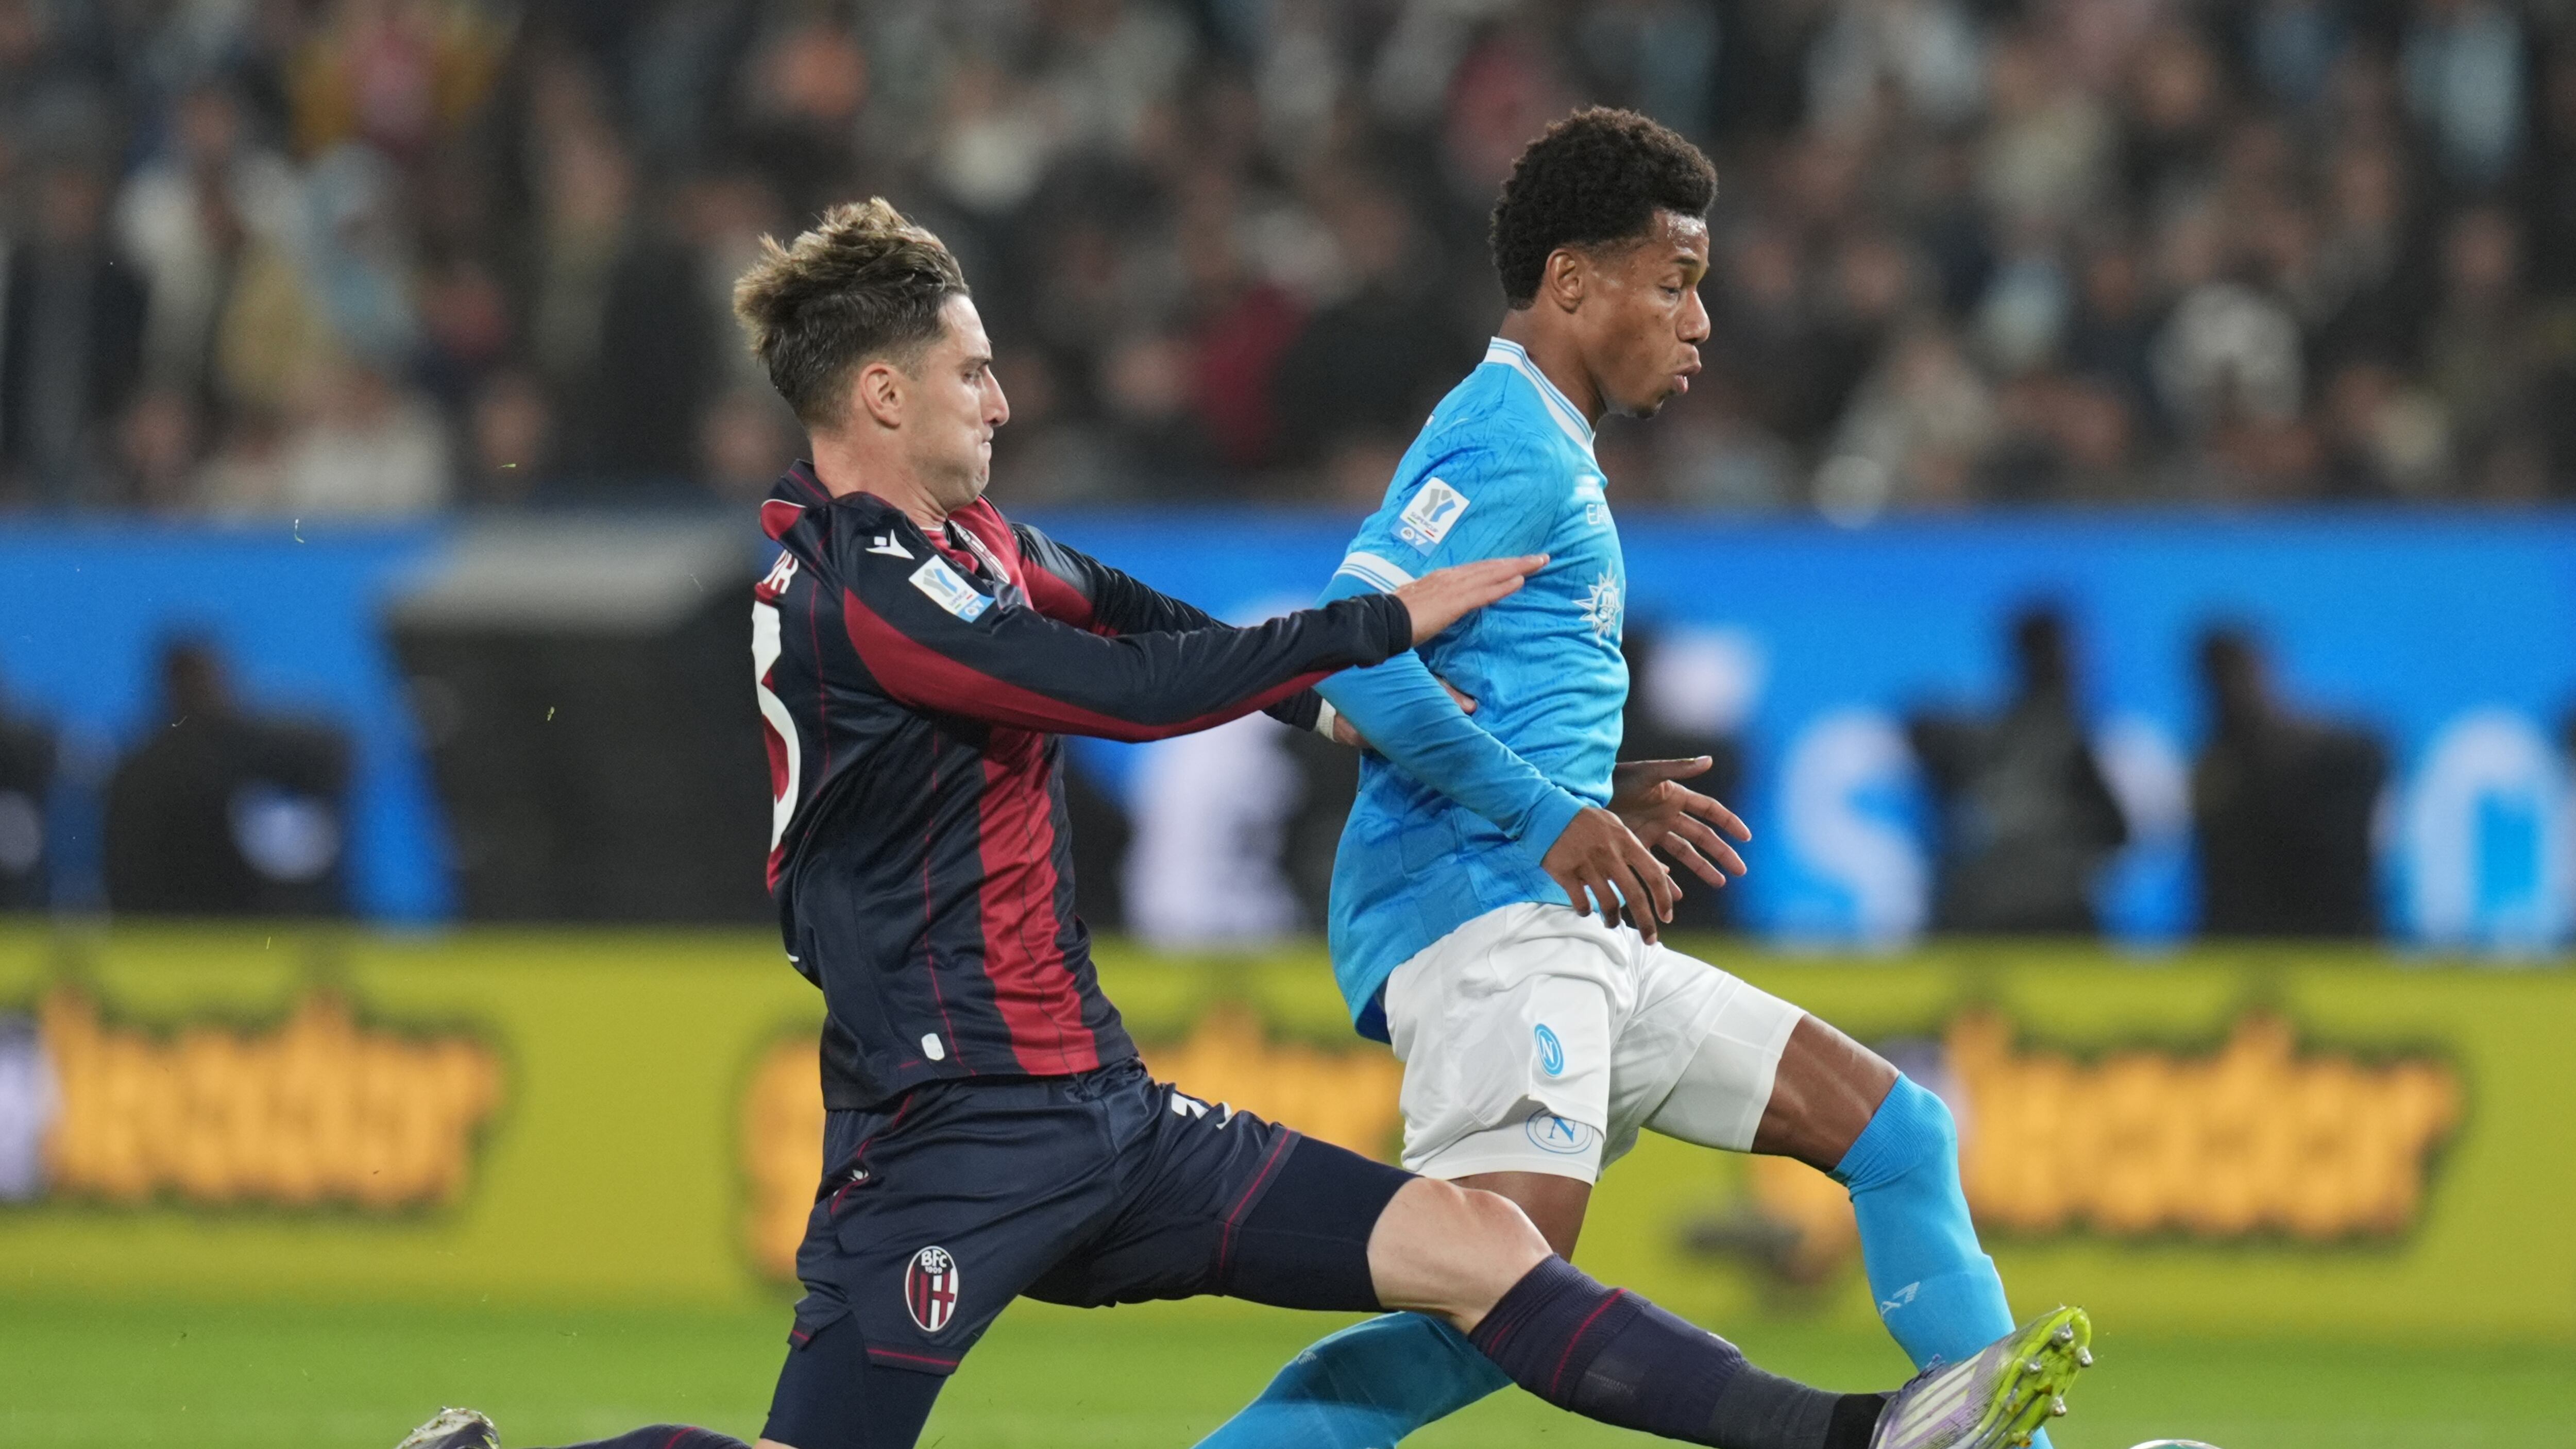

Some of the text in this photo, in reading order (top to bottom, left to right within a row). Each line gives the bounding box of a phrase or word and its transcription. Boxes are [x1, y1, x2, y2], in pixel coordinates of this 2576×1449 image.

[1540, 1034, 1554, 1064] N
[1547, 1116, 1576, 1143] N
[921, 1249, 947, 1268] BFC
